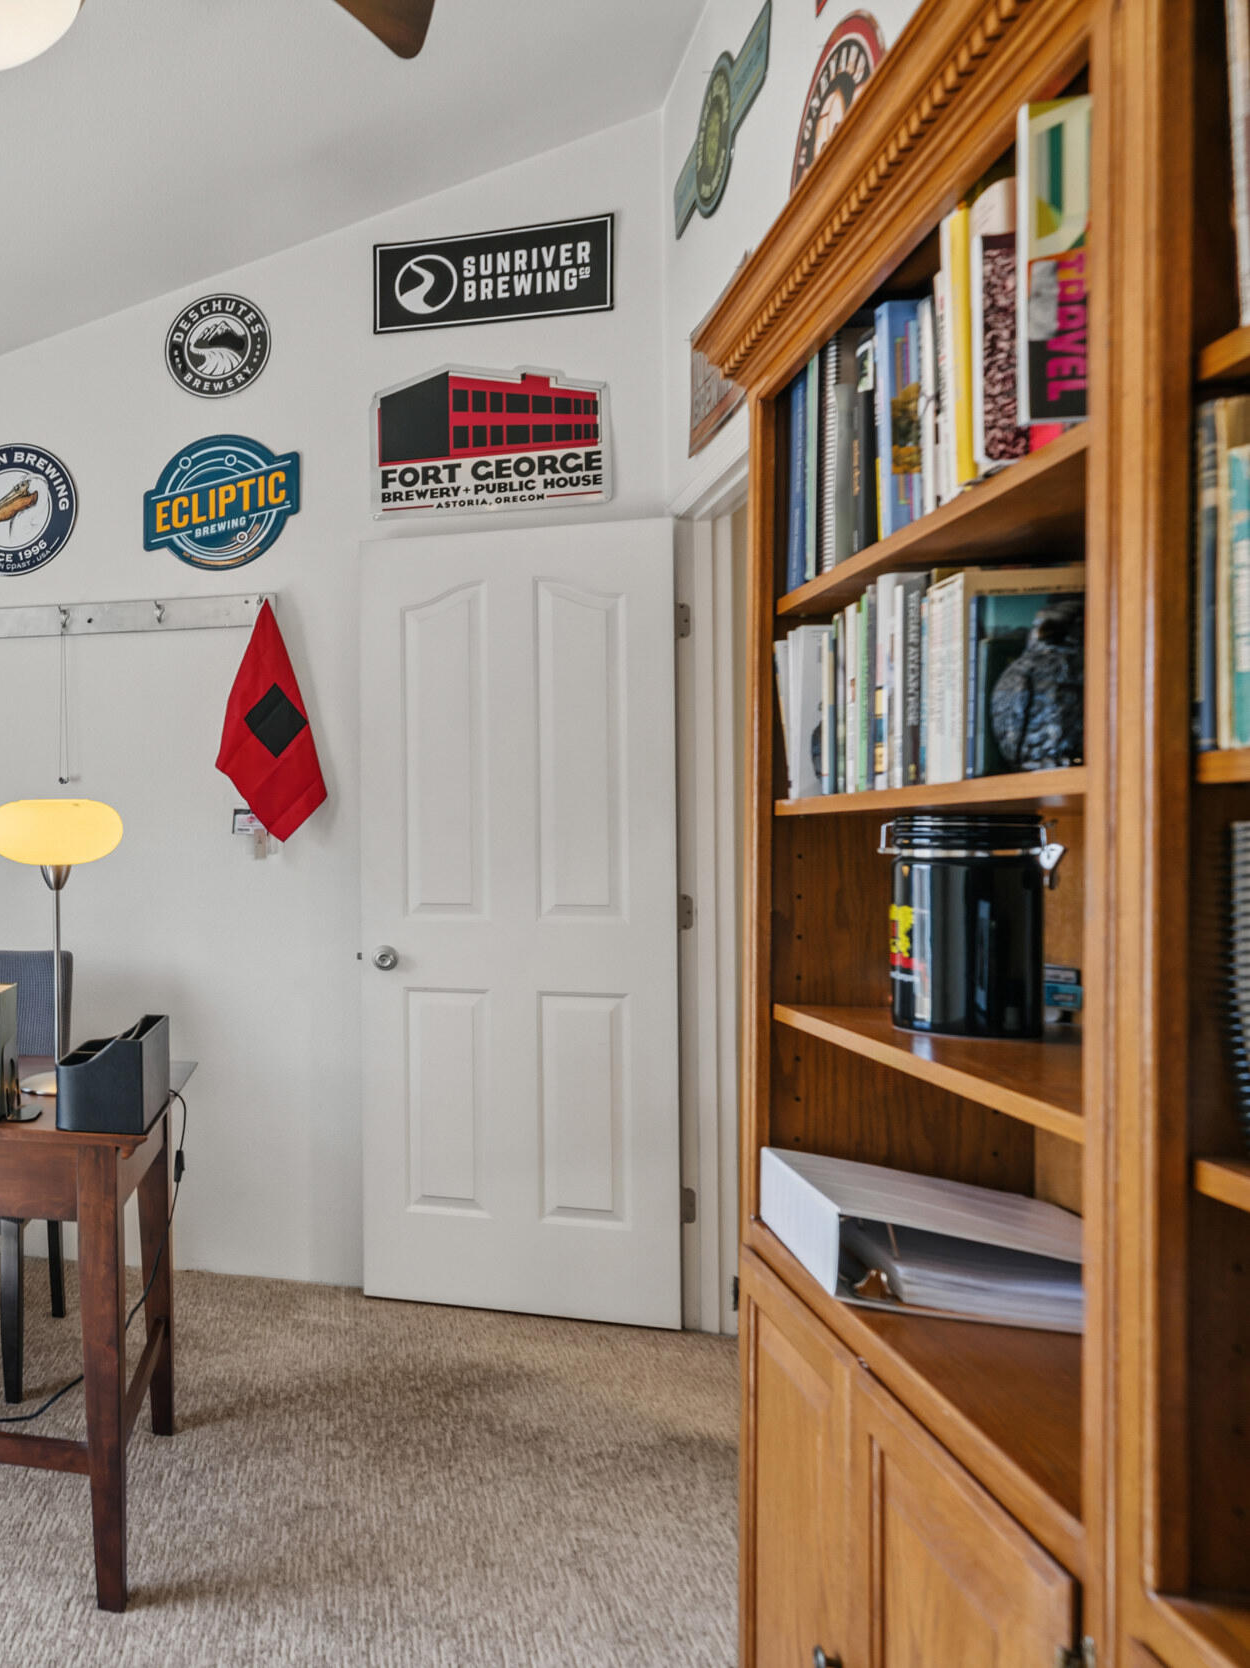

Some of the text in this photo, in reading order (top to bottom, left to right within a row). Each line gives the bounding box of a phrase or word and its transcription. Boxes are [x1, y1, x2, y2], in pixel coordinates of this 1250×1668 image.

[463, 241, 591, 279] SUNRIVER
[463, 267, 578, 303] BREWING
[173, 300, 263, 343] DESCHUTES
[184, 366, 251, 391] BREWERY
[13, 452, 70, 511] BREWING
[381, 450, 602, 489] FORT GEORGE
[156, 470, 287, 534] ECLIPTIC
[381, 487, 461, 503] BREWERY
[474, 479, 536, 496] PUBLIC
[543, 473, 603, 490] HOUSE
[435, 494, 545, 509] ASTORIA, OREGON
[194, 516, 247, 539] BREWING
[6, 561, 30, 570] COAST
[36, 550, 51, 562] USA
[19, 540, 48, 561] 1996
